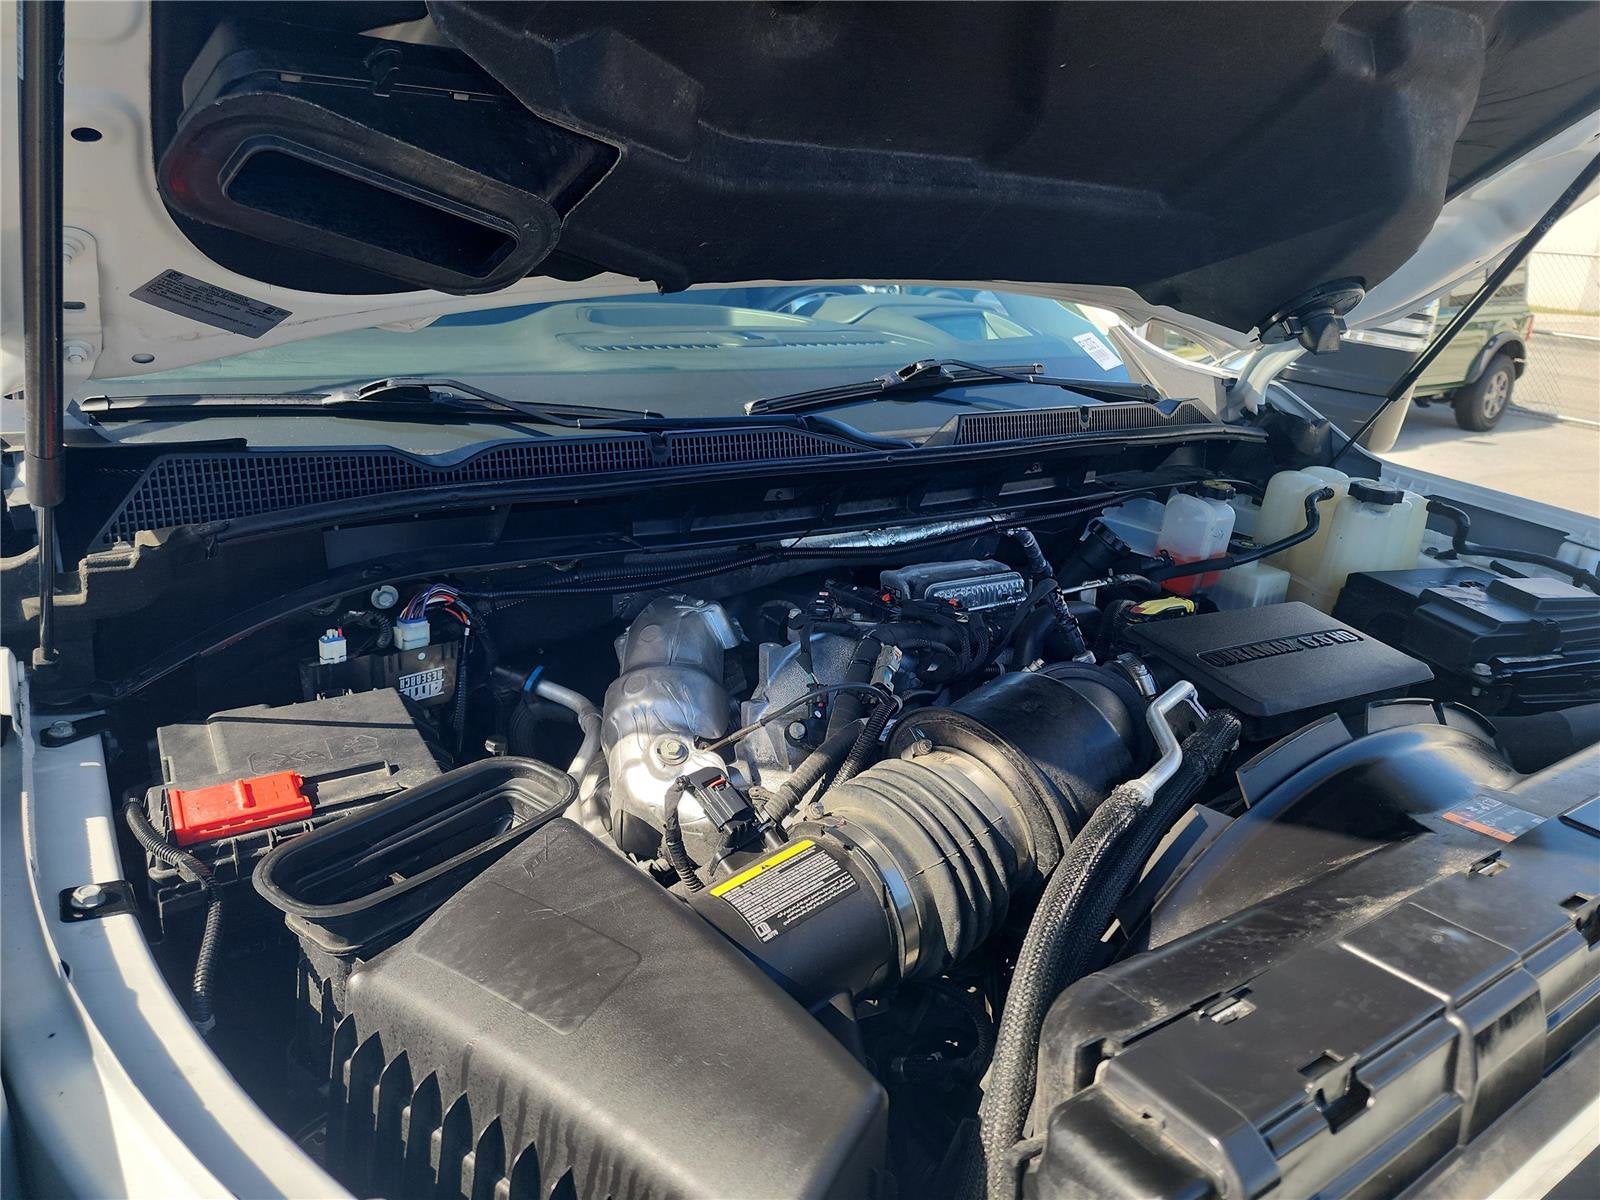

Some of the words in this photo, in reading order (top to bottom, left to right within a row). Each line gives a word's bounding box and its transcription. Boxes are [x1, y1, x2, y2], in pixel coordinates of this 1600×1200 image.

[1208, 639, 1303, 667] DURAMAX
[1297, 634, 1333, 649] 6.6
[1324, 630, 1358, 643] HD
[399, 670, 443, 690] RESEARCH
